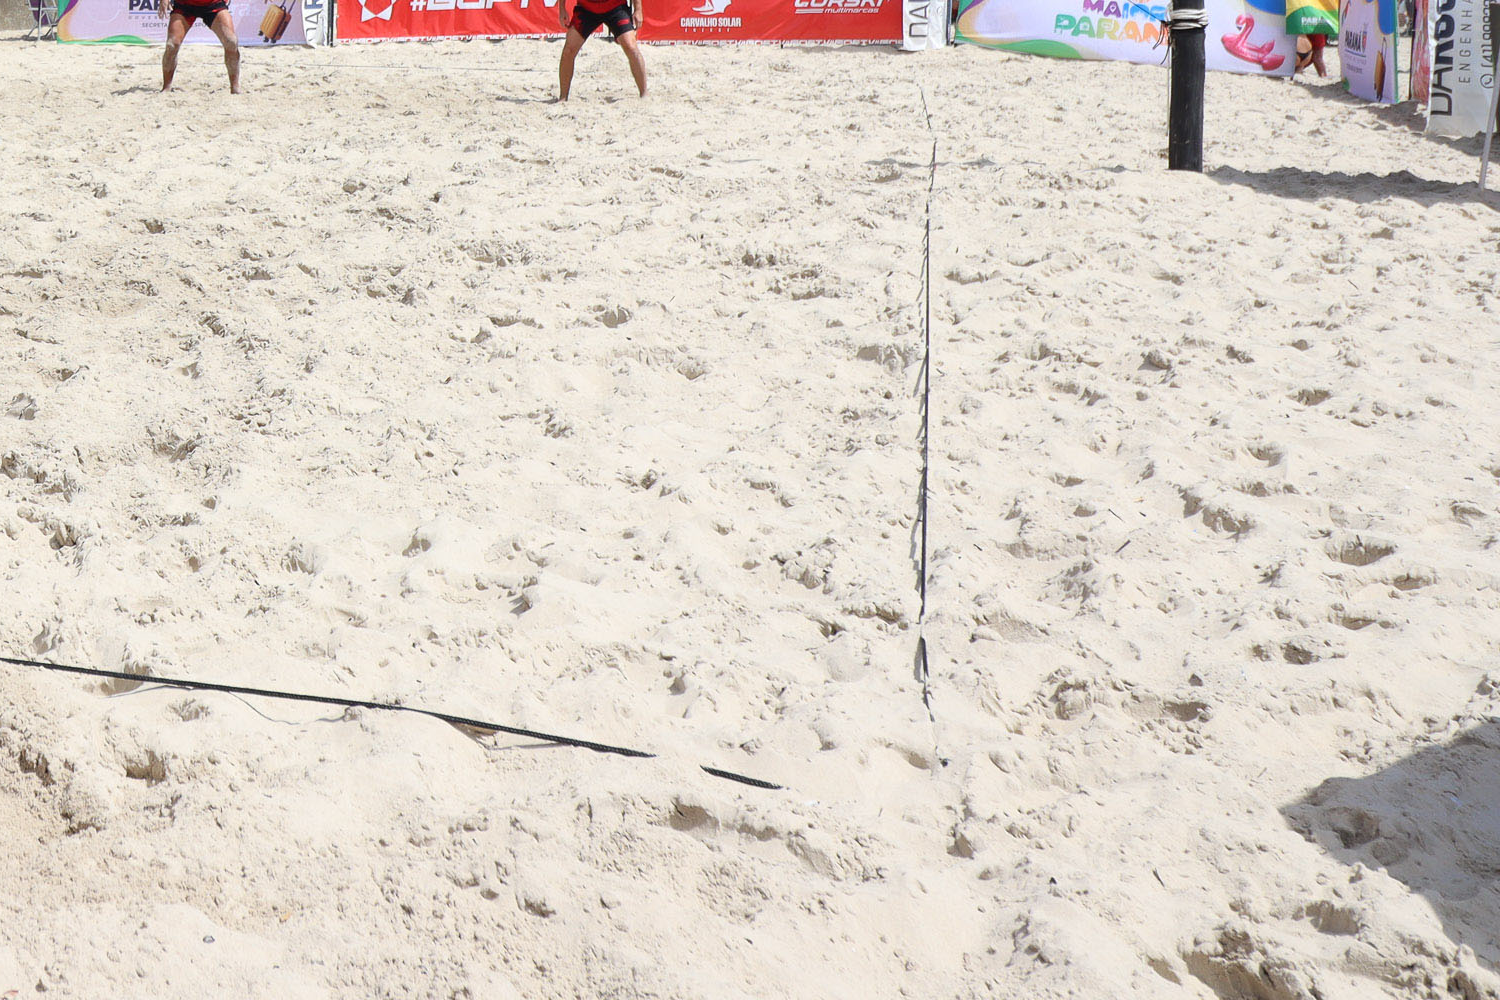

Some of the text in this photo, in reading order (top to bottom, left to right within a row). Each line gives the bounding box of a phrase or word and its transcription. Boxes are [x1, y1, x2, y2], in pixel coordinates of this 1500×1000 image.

[680, 17, 742, 28] CARVALHO SOLAR
[1053, 13, 1169, 46] PARAN
